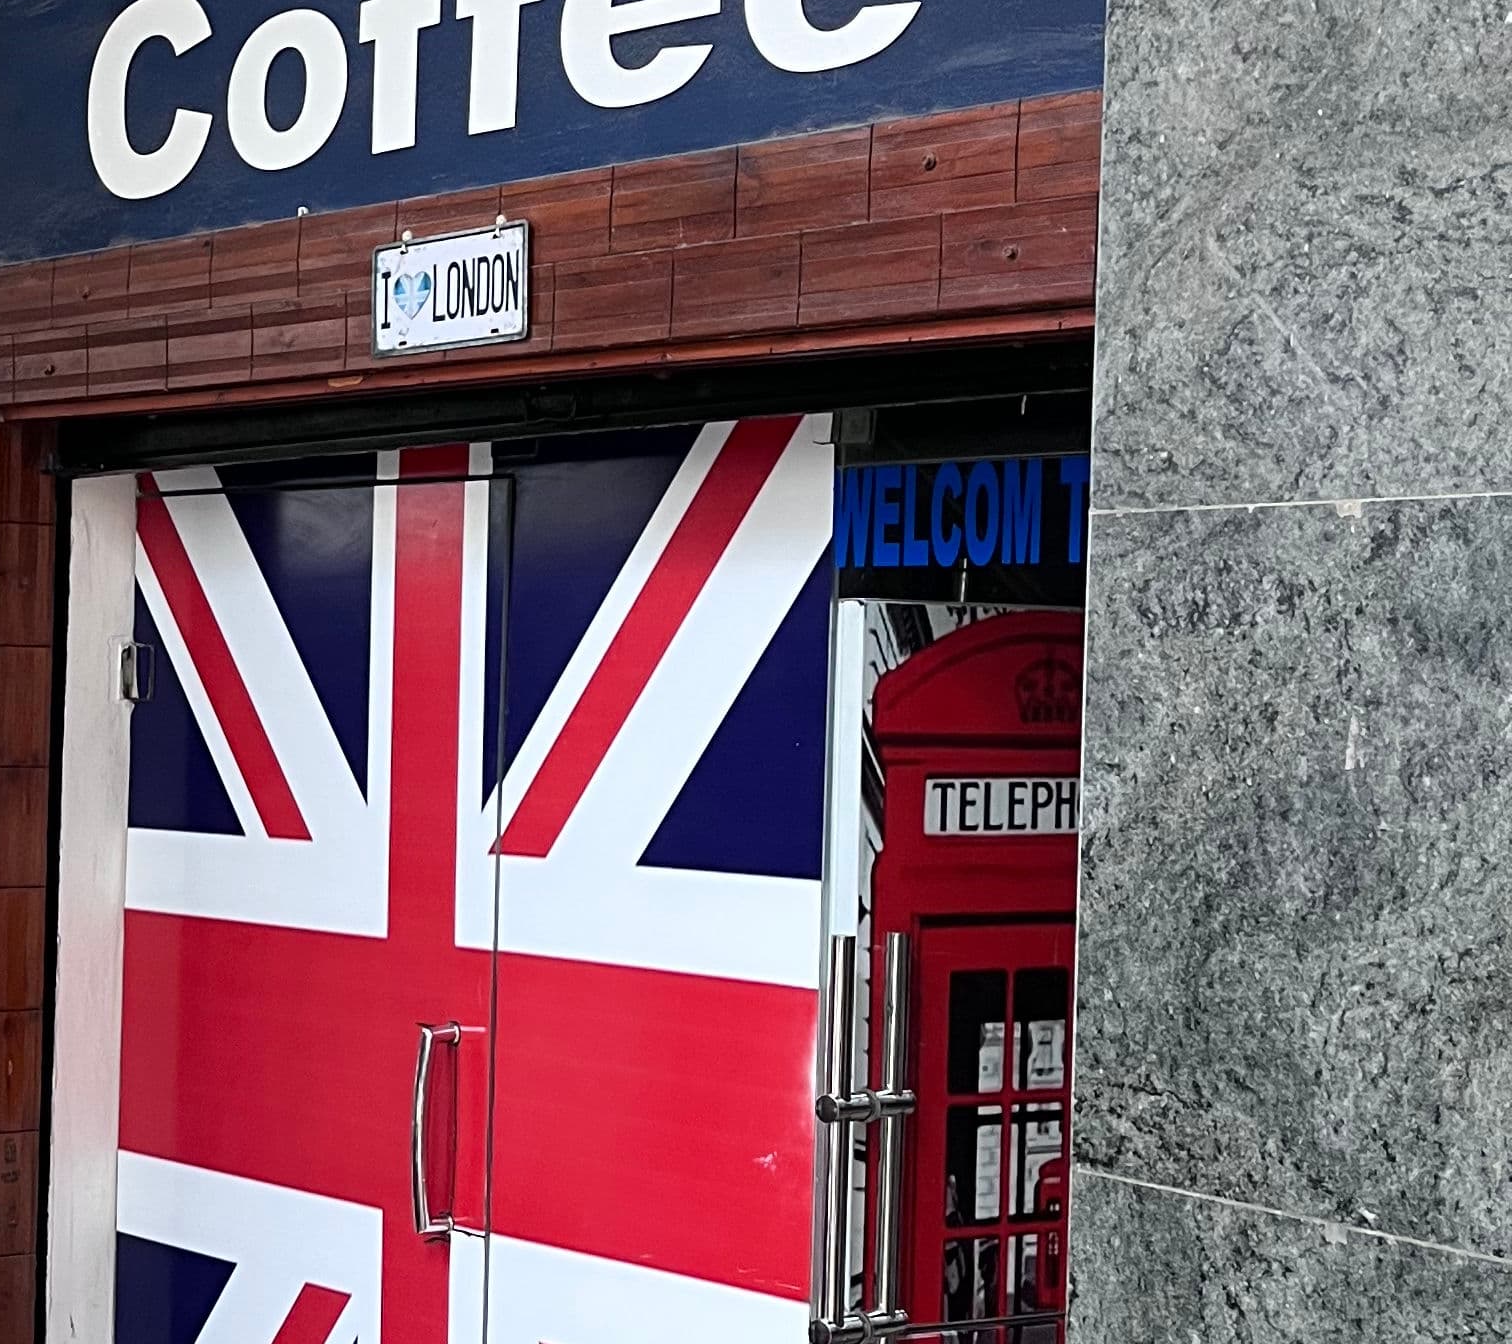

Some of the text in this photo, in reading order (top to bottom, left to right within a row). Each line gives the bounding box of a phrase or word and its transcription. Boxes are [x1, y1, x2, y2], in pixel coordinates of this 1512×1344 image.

[381, 250, 519, 329] I LONDON
[834, 457, 1042, 569] WELCOM
[932, 781, 1080, 832] TELEPH
